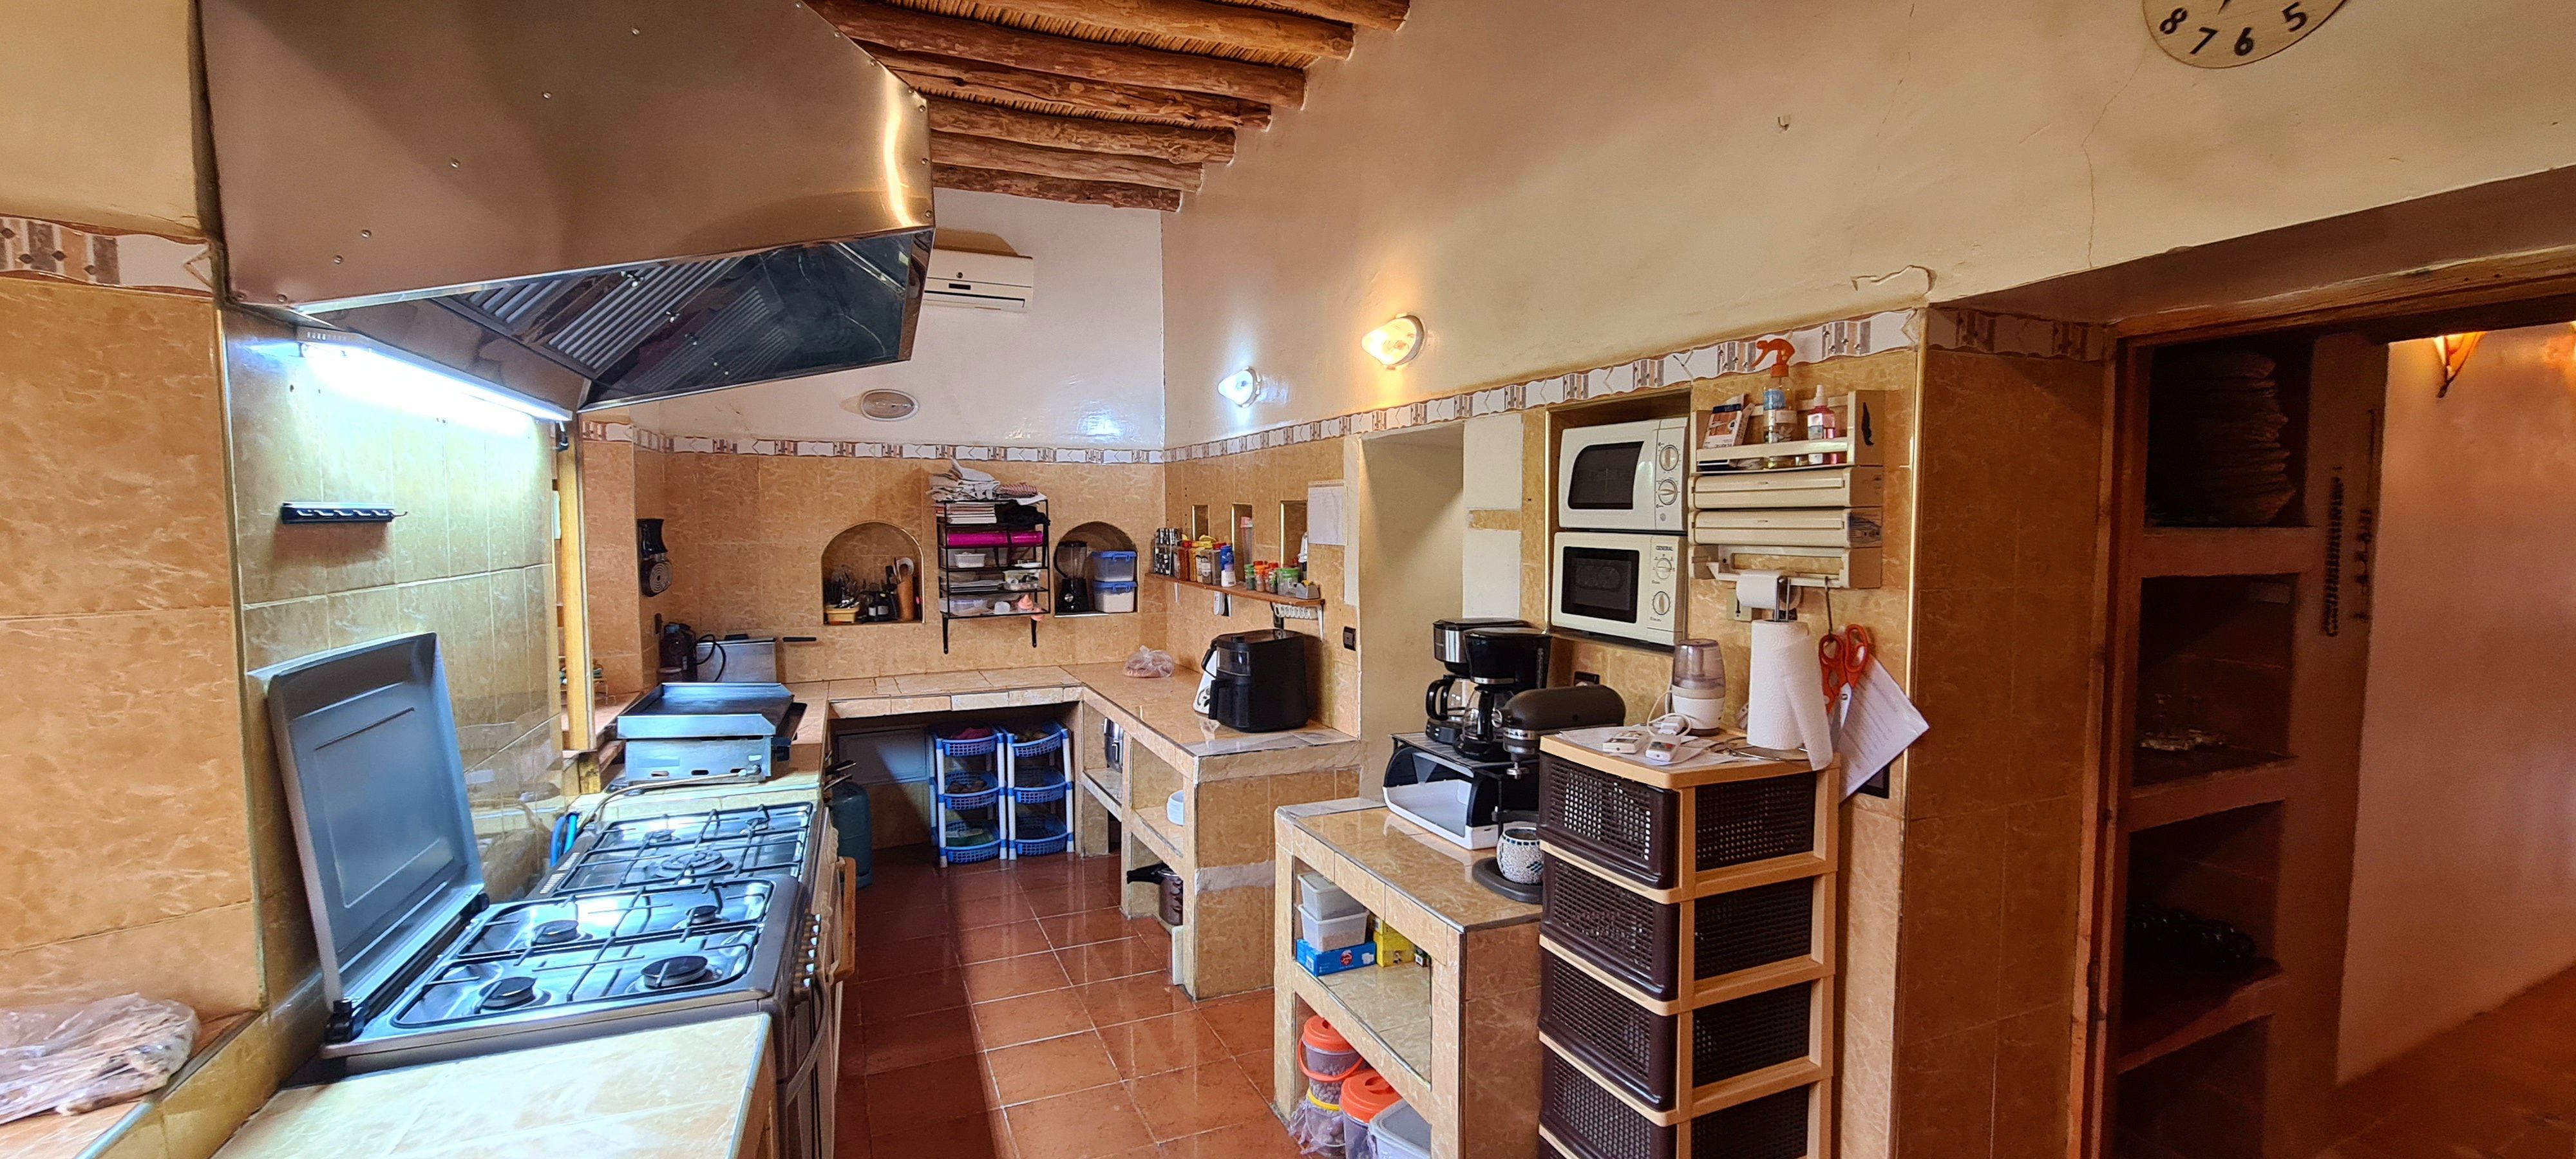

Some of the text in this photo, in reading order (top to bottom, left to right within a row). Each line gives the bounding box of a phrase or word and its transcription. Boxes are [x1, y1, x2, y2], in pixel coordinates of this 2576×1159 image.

[2159, 7, 2188, 34] 8
[2282, 1, 2308, 32] 5
[2190, 26, 2219, 55] 7
[2233, 27, 2254, 56] 6
